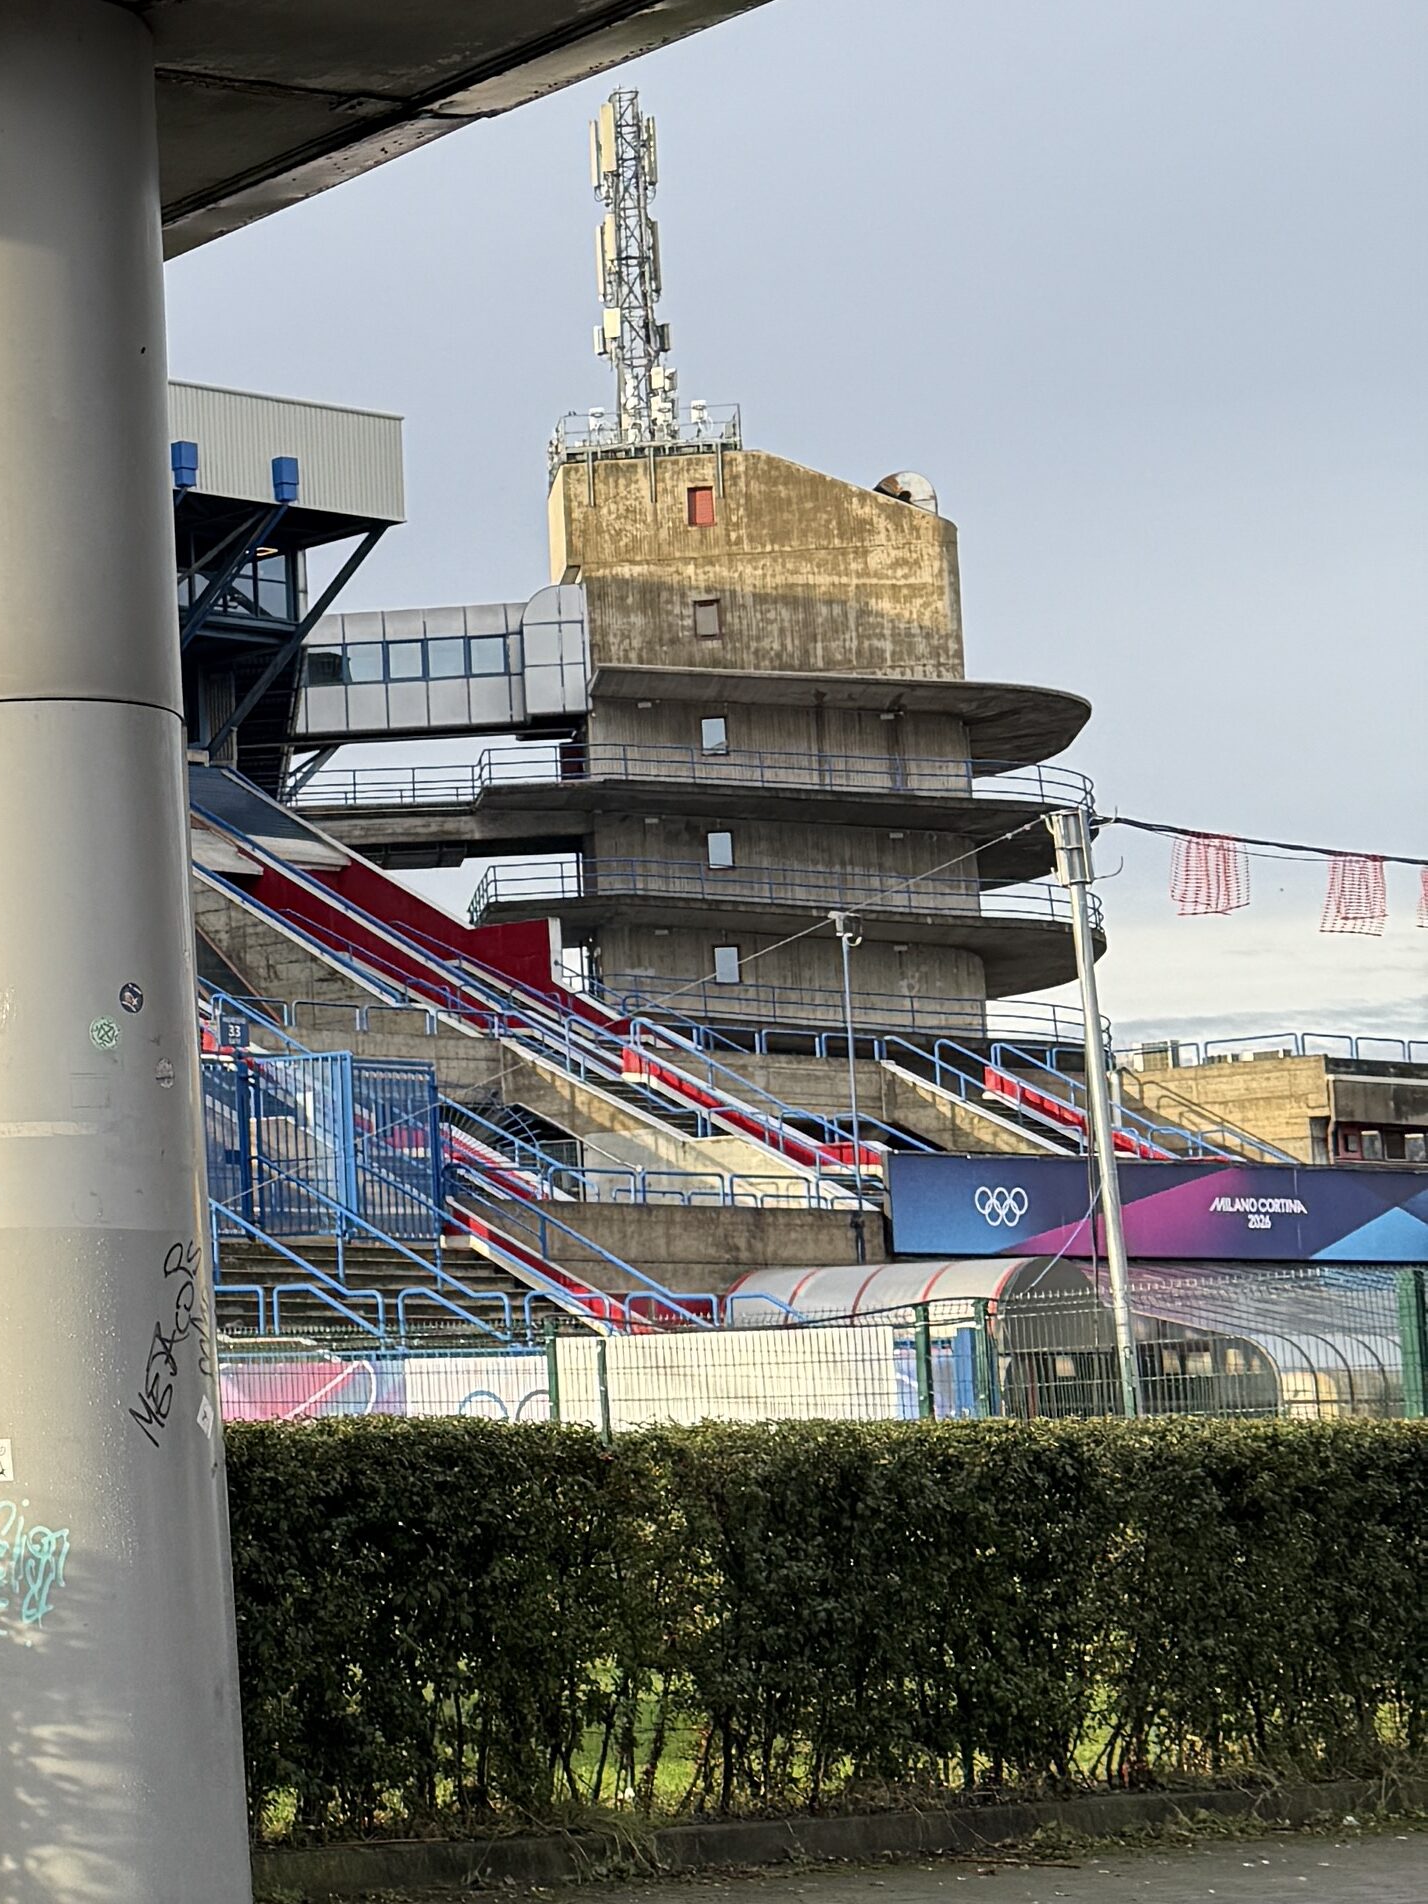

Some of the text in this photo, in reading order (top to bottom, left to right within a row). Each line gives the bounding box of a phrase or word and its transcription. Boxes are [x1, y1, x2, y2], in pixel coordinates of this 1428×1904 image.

[228, 1025, 241, 1038] 33
[1209, 1197, 1308, 1214] MILANO CORTINA
[1247, 1215, 1272, 1228] 2026
